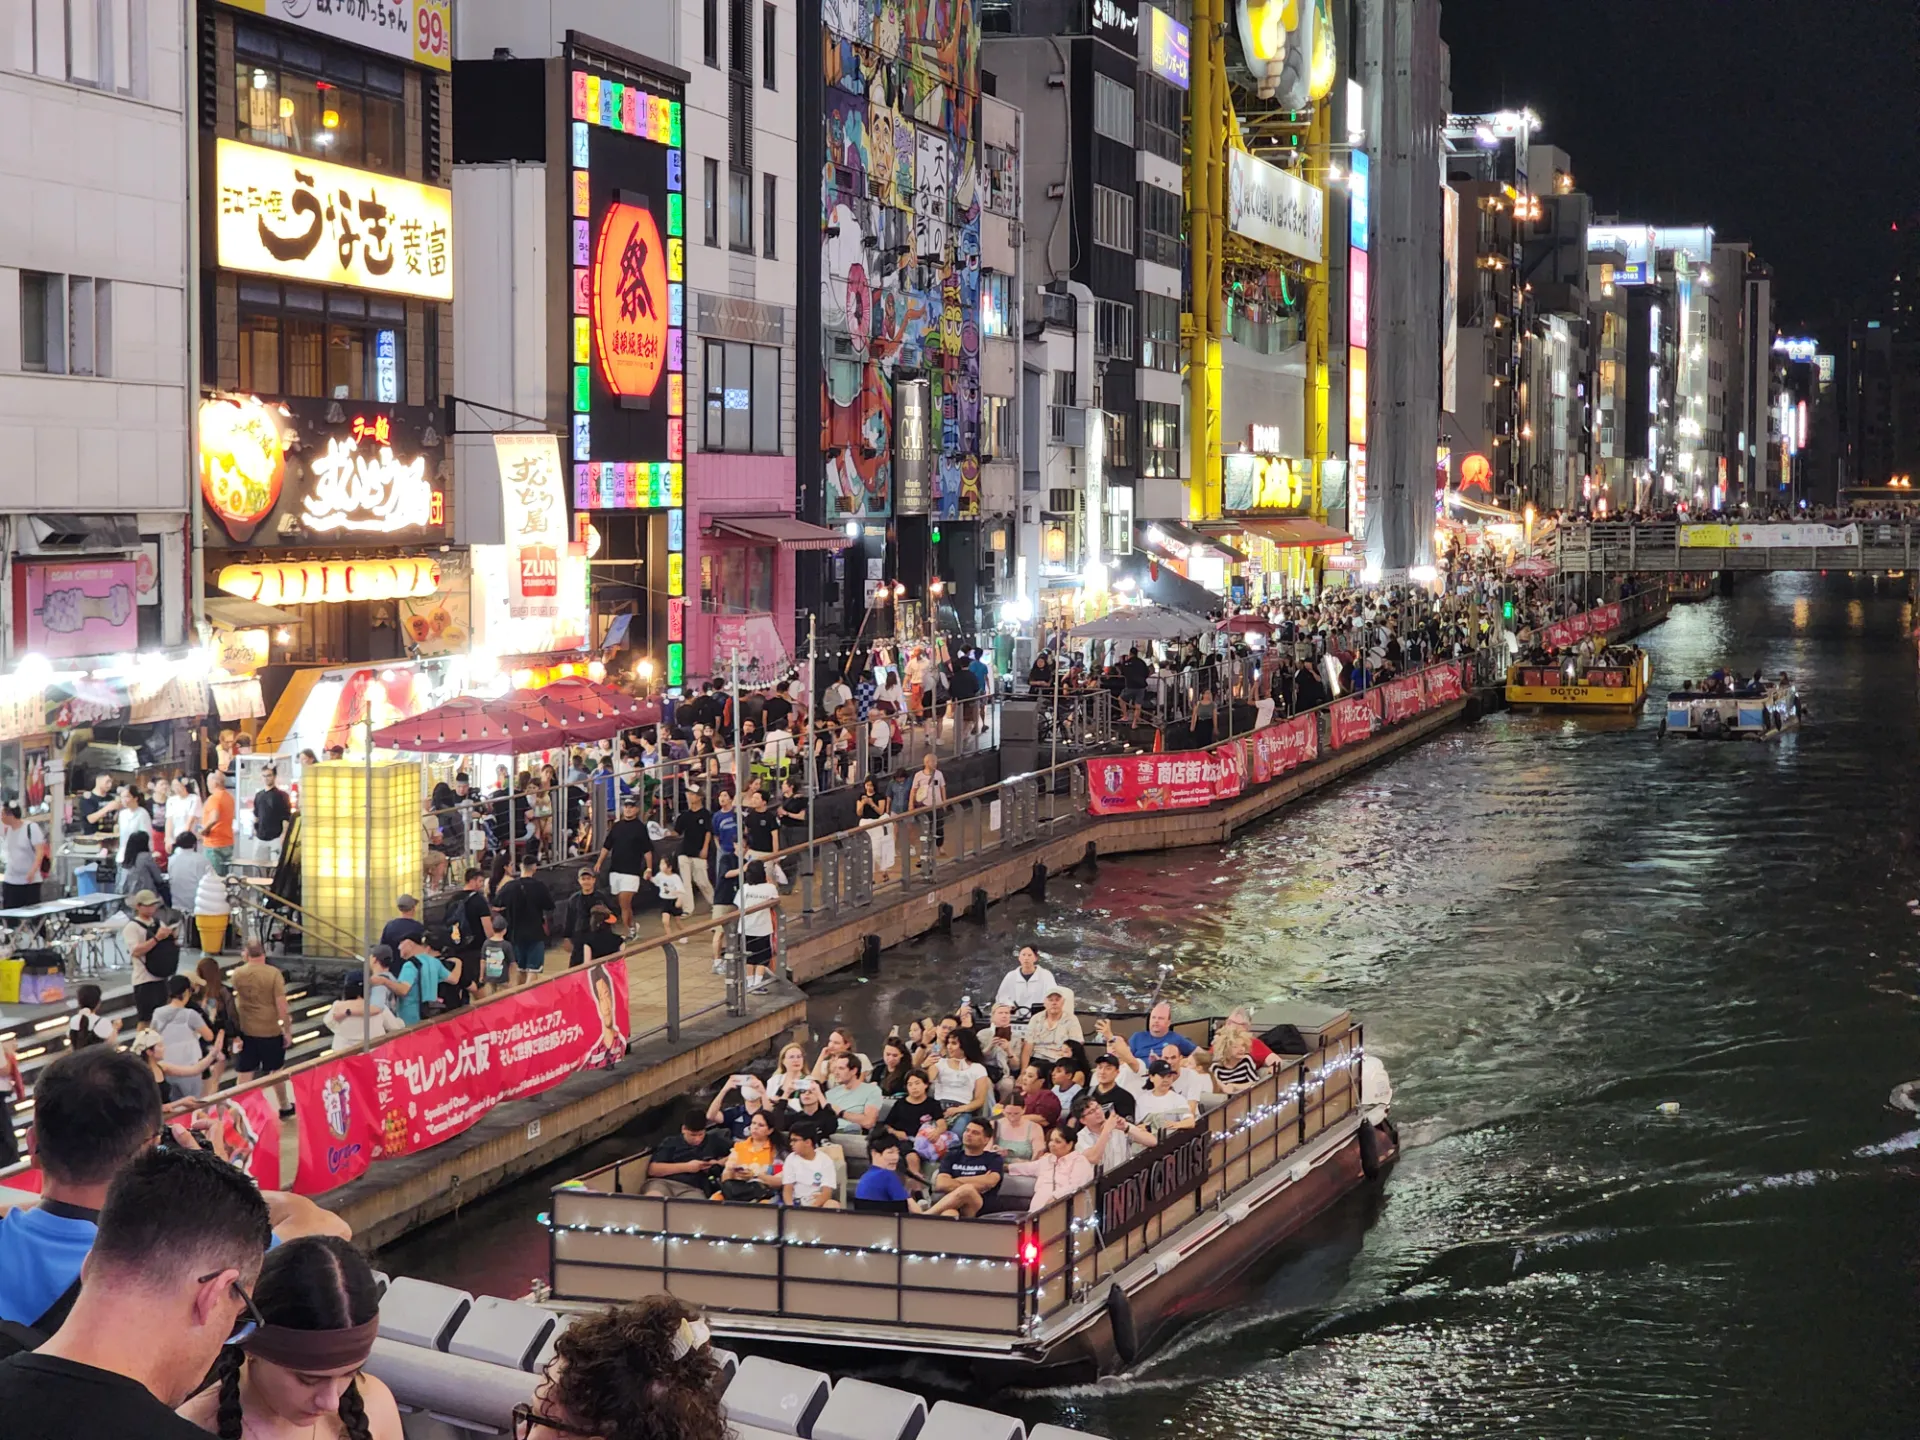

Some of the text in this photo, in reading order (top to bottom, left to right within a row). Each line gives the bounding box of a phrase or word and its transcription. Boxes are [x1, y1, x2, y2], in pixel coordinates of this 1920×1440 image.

[419, 7, 442, 55] 99
[258, 169, 396, 276] うなぎ
[400, 218, 446, 277] 菱富
[614, 220, 658, 325] 祭
[522, 560, 556, 576] ZUN
[1550, 688, 1588, 696] DOTON
[1102, 1131, 1212, 1234] INDY CRUISE
